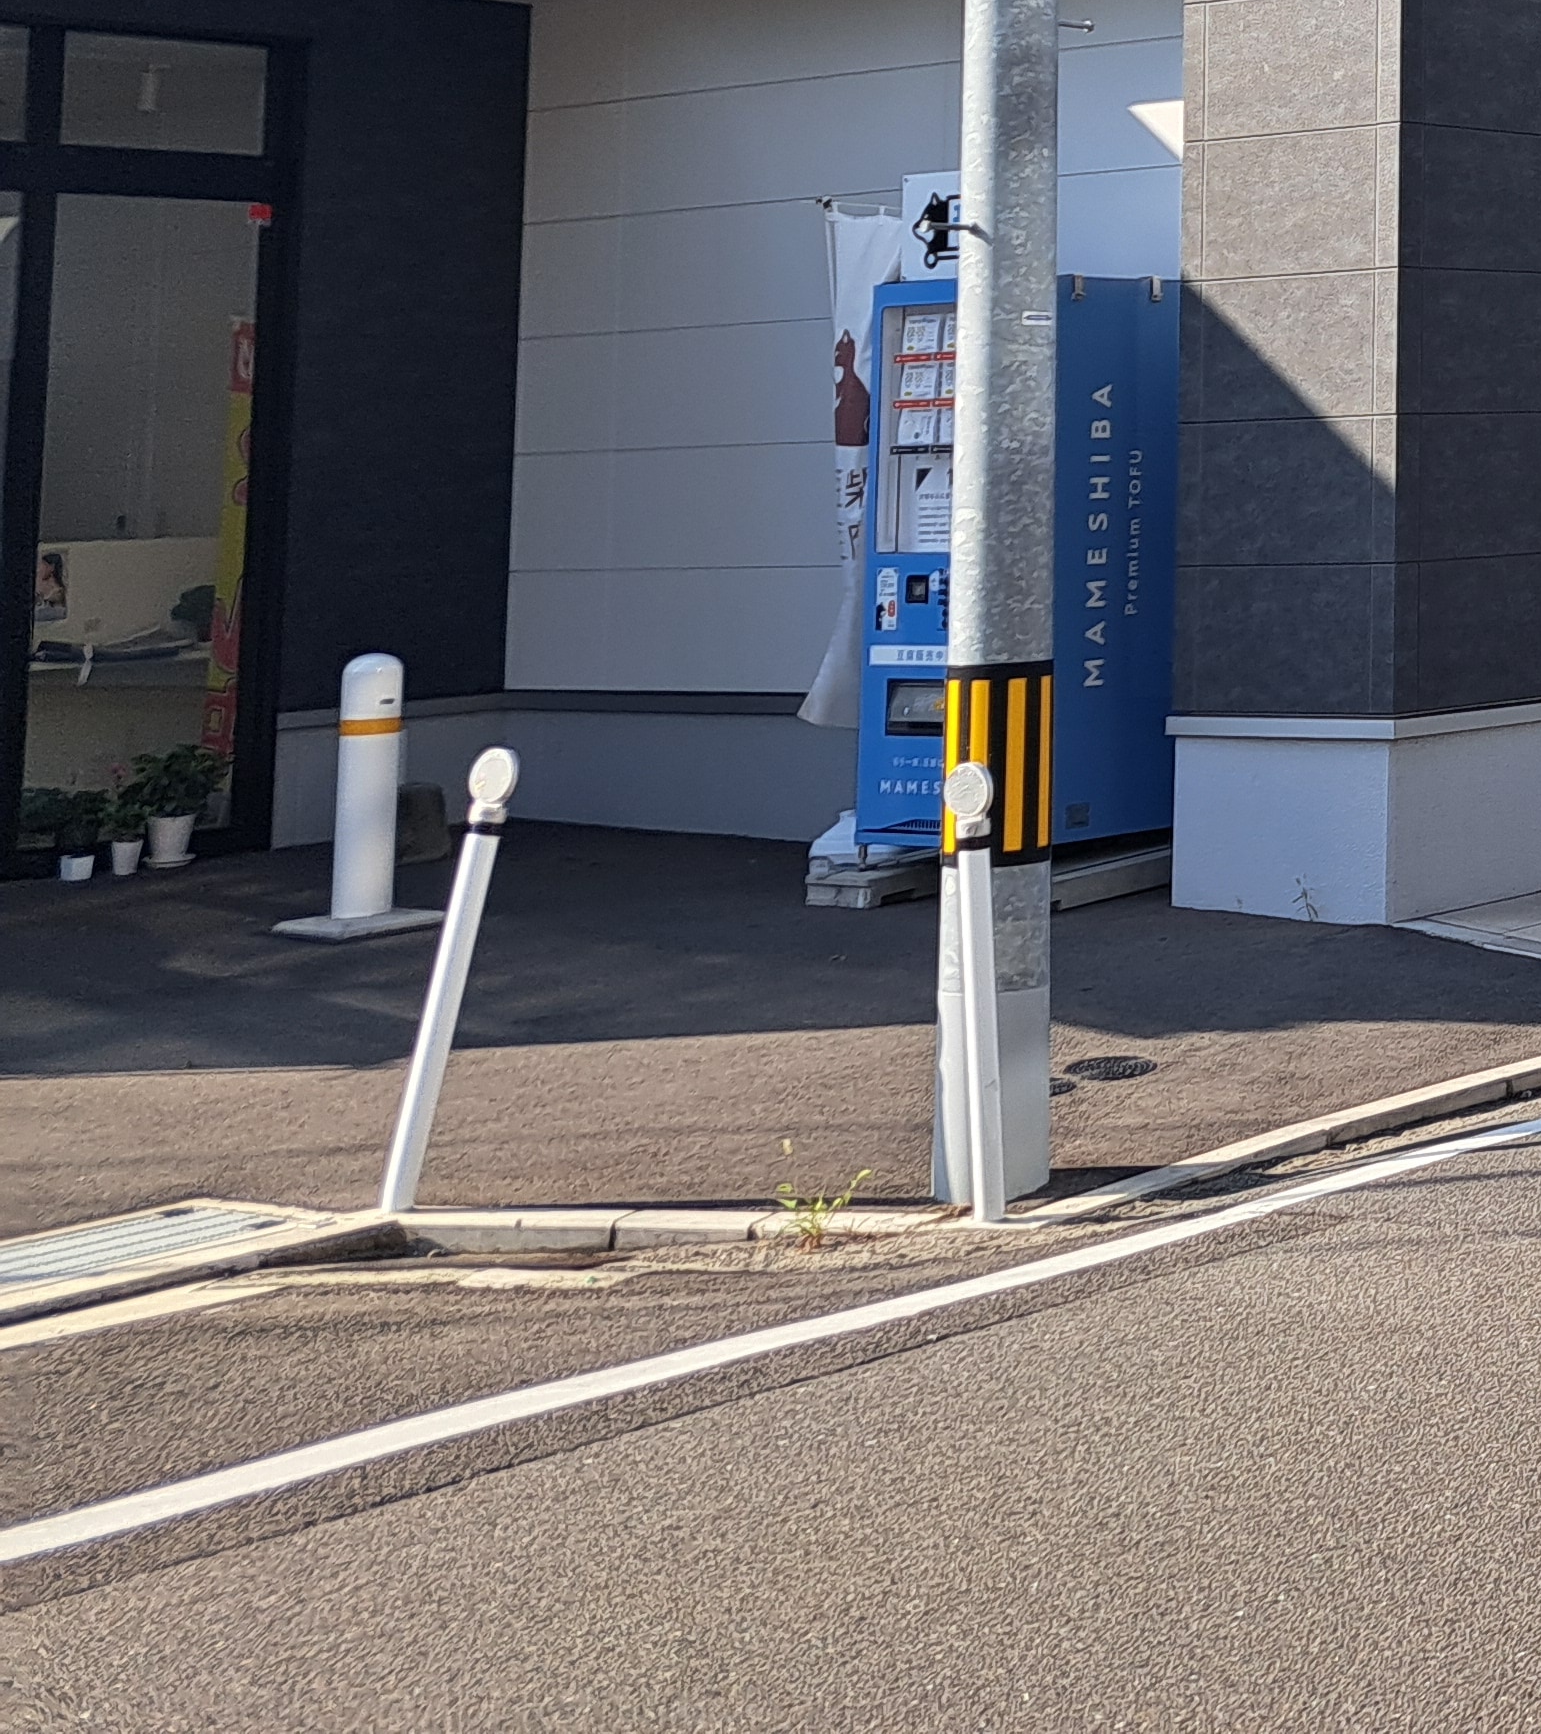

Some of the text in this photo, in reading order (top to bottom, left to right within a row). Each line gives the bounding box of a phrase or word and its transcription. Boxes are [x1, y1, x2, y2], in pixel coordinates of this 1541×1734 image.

[1083, 383, 1112, 688] MAMESHIBA
[1123, 449, 1143, 616] Premium TOFU
